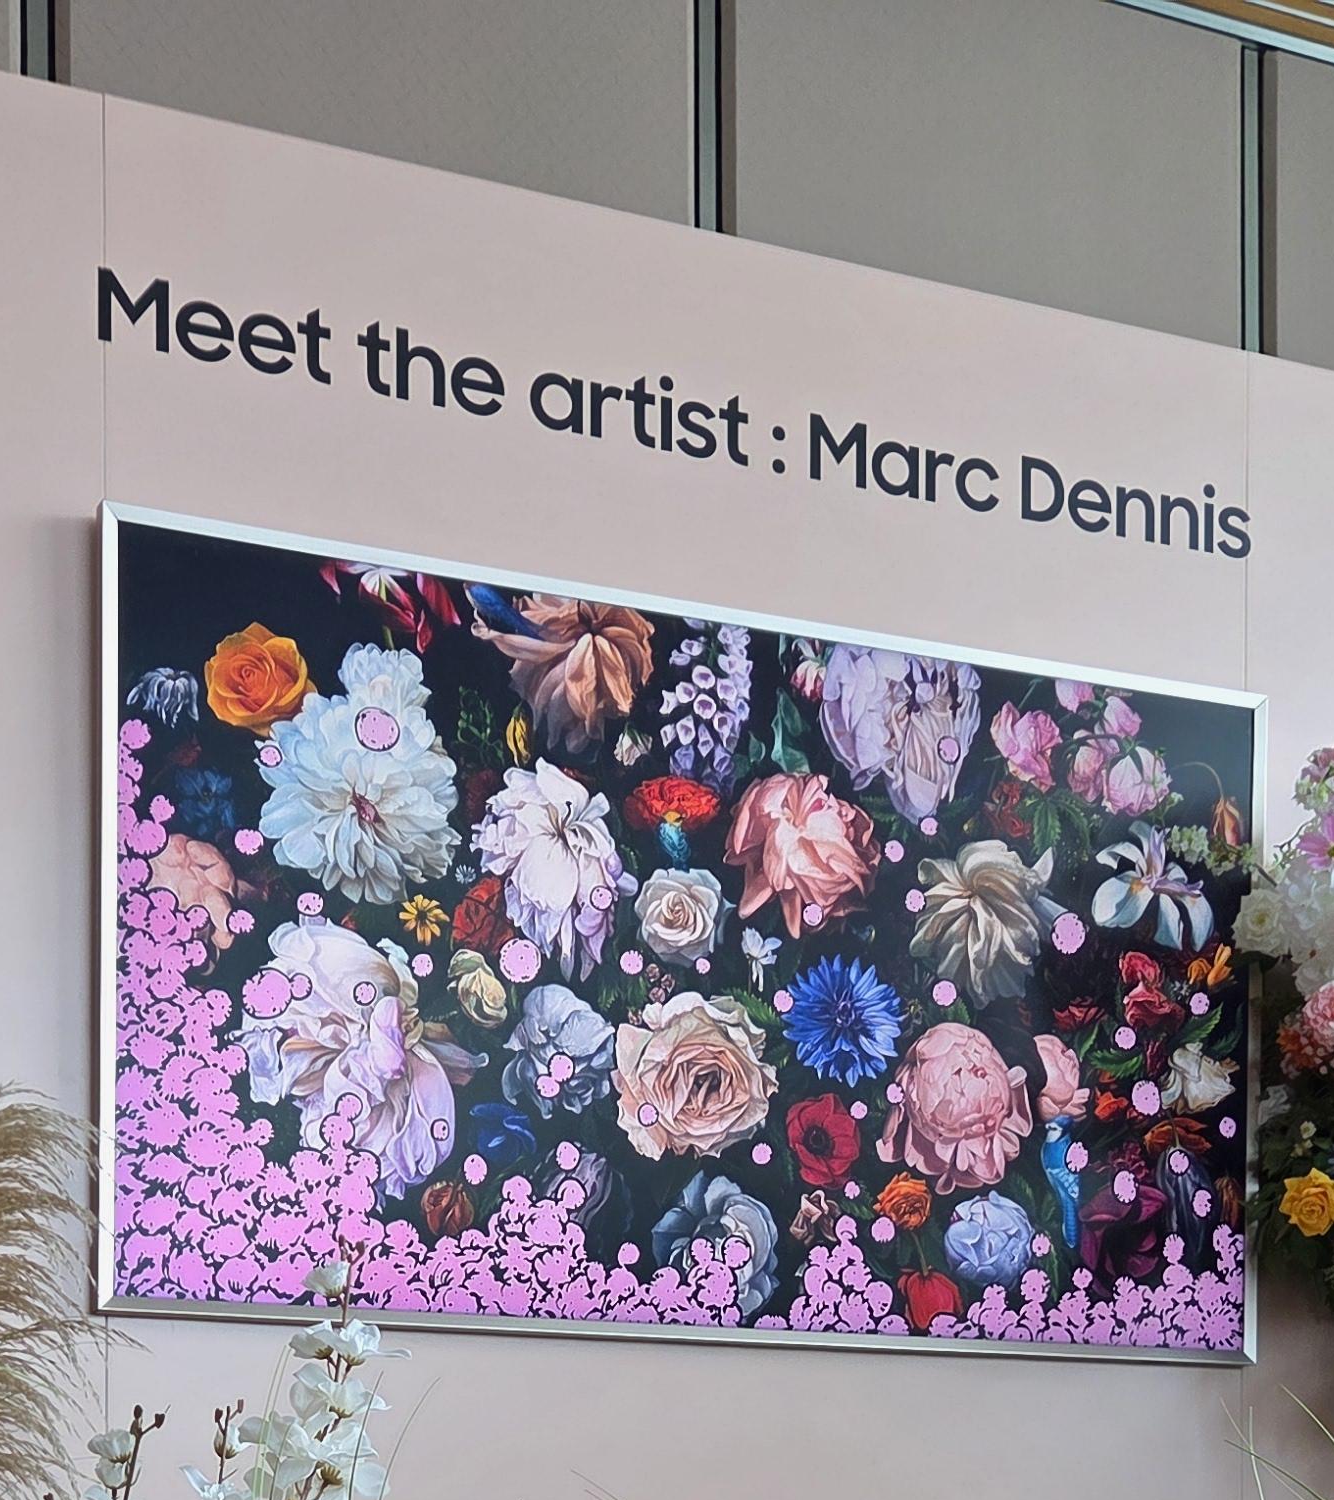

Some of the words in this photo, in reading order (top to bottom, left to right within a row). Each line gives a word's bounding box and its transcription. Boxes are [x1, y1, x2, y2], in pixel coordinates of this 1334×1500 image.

[96, 266, 332, 385] Meet
[357, 321, 505, 417] the
[529, 374, 749, 467] artist
[809, 412, 999, 513] Marc
[1021, 455, 1252, 560] Dennis
